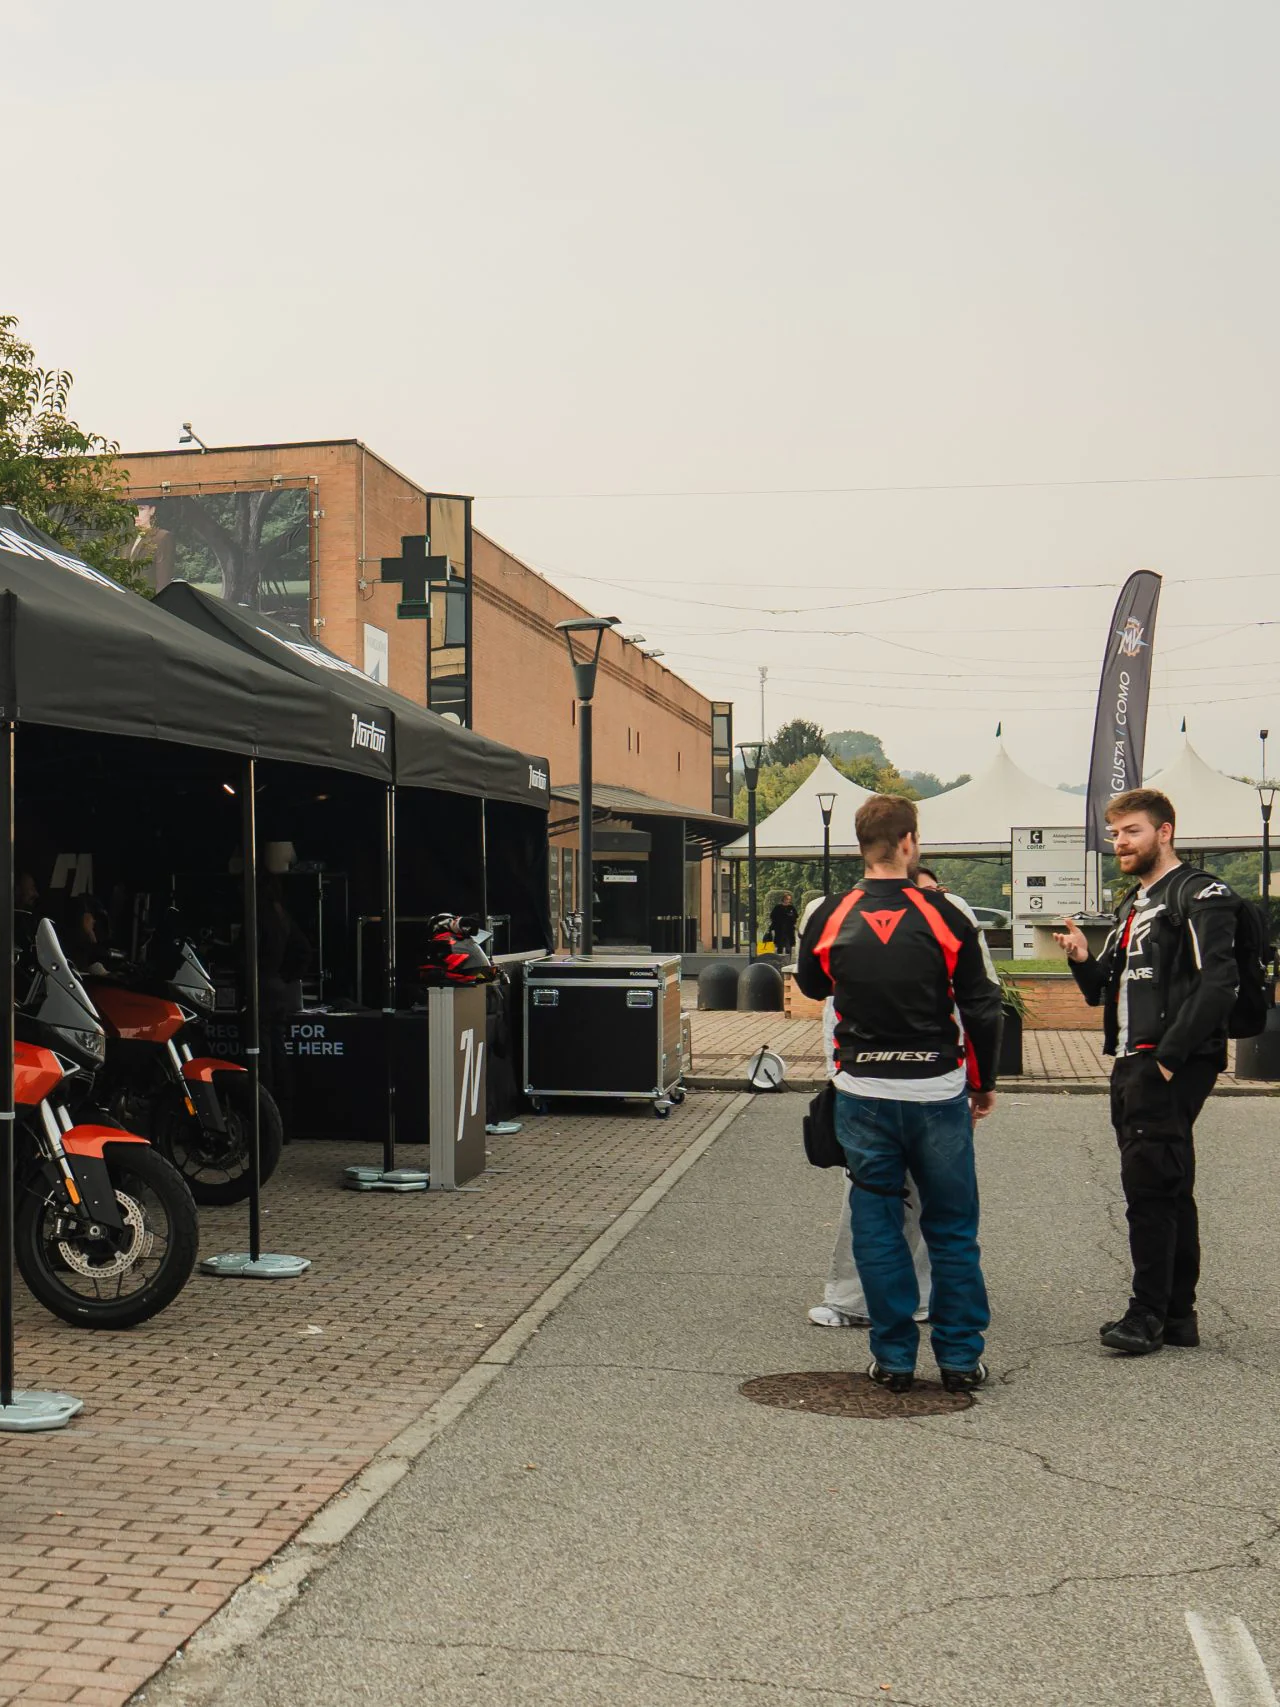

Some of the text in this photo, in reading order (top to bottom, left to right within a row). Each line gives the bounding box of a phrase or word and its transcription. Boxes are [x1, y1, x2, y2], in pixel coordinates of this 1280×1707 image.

[1115, 671, 1131, 725] COMO
[351, 713, 387, 753] Norton
[291, 1024, 325, 1038] FOR
[208, 1042, 245, 1055] YOU
[299, 1042, 344, 1055] HERE
[856, 1051, 940, 1063] DAINESE
